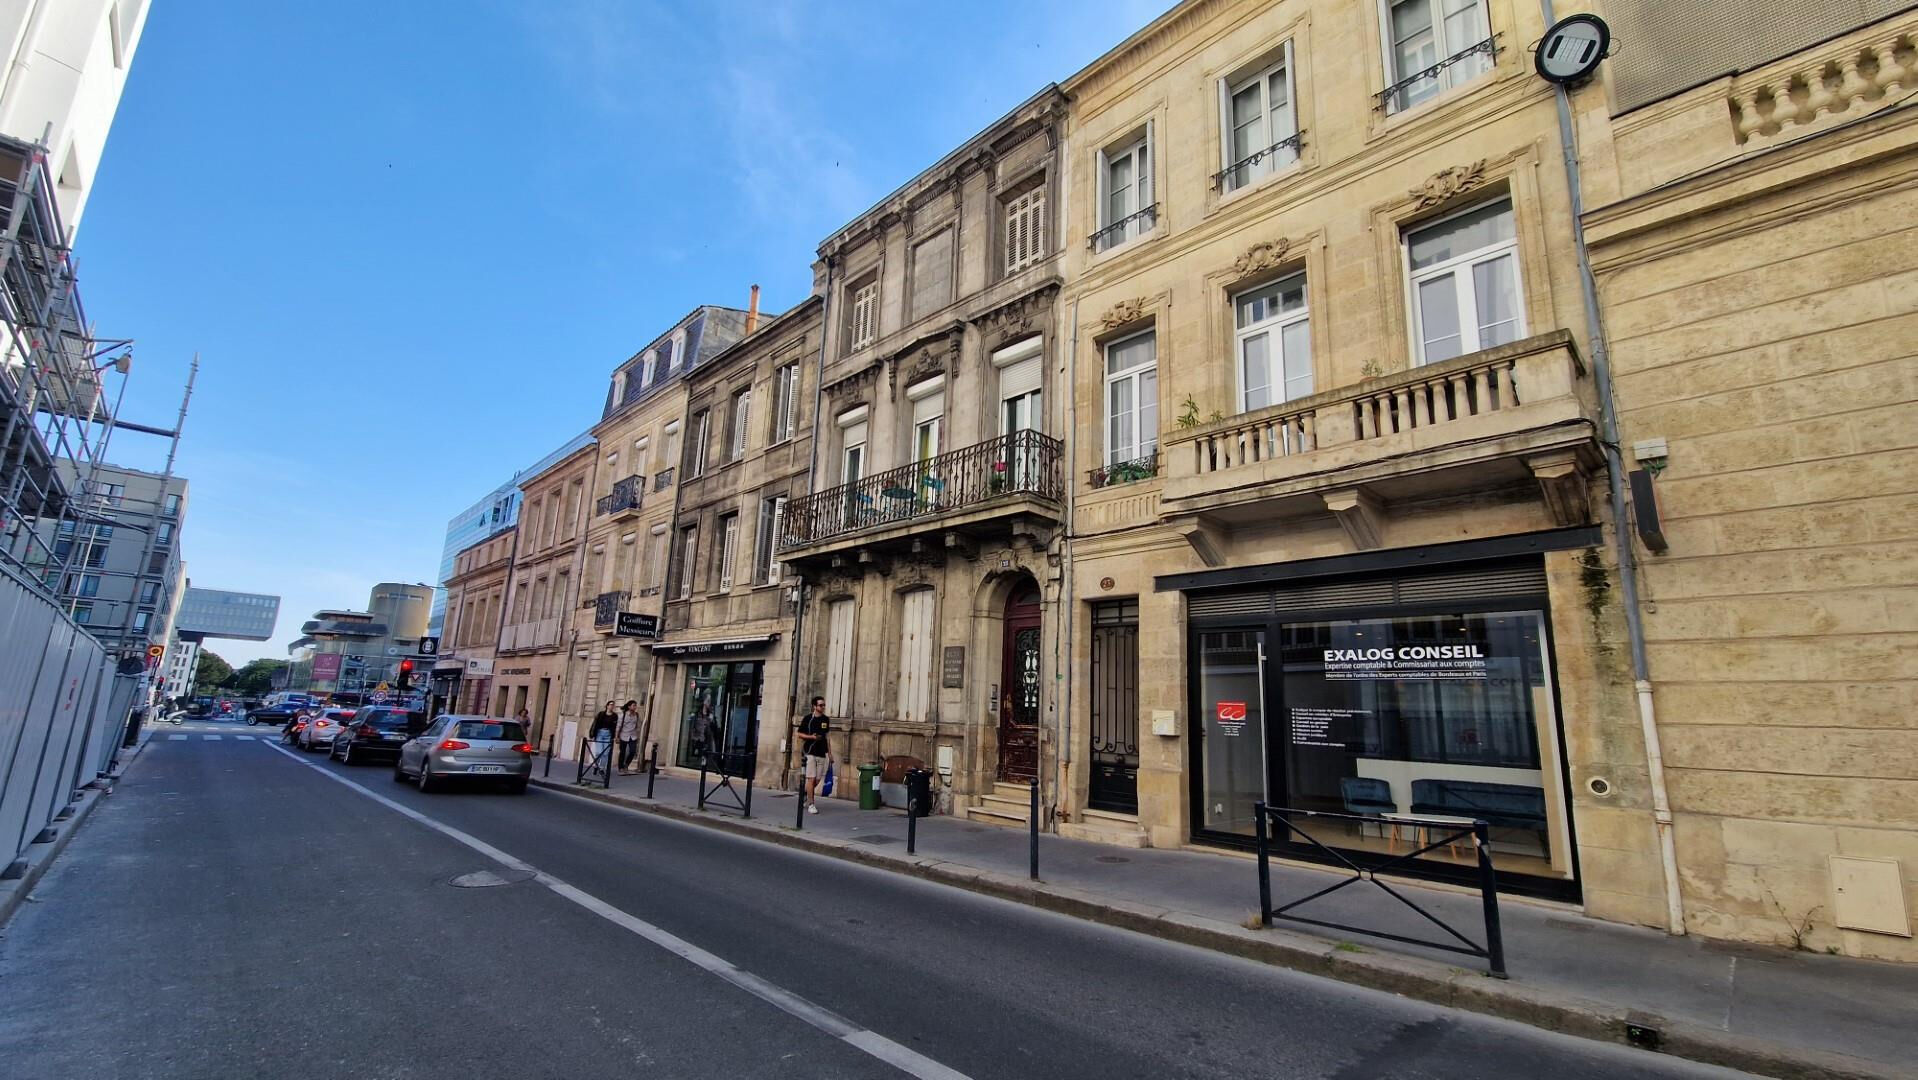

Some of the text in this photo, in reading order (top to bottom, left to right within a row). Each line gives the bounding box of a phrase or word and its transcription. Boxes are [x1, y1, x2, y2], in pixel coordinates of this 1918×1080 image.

[1324, 645, 1484, 662] EXALOG CONSEIL
[1325, 662, 1352, 671] Expertise
[1353, 660, 1386, 670] comptable
[1393, 660, 1438, 669] Commissariat
[1454, 660, 1486, 668] comptes
